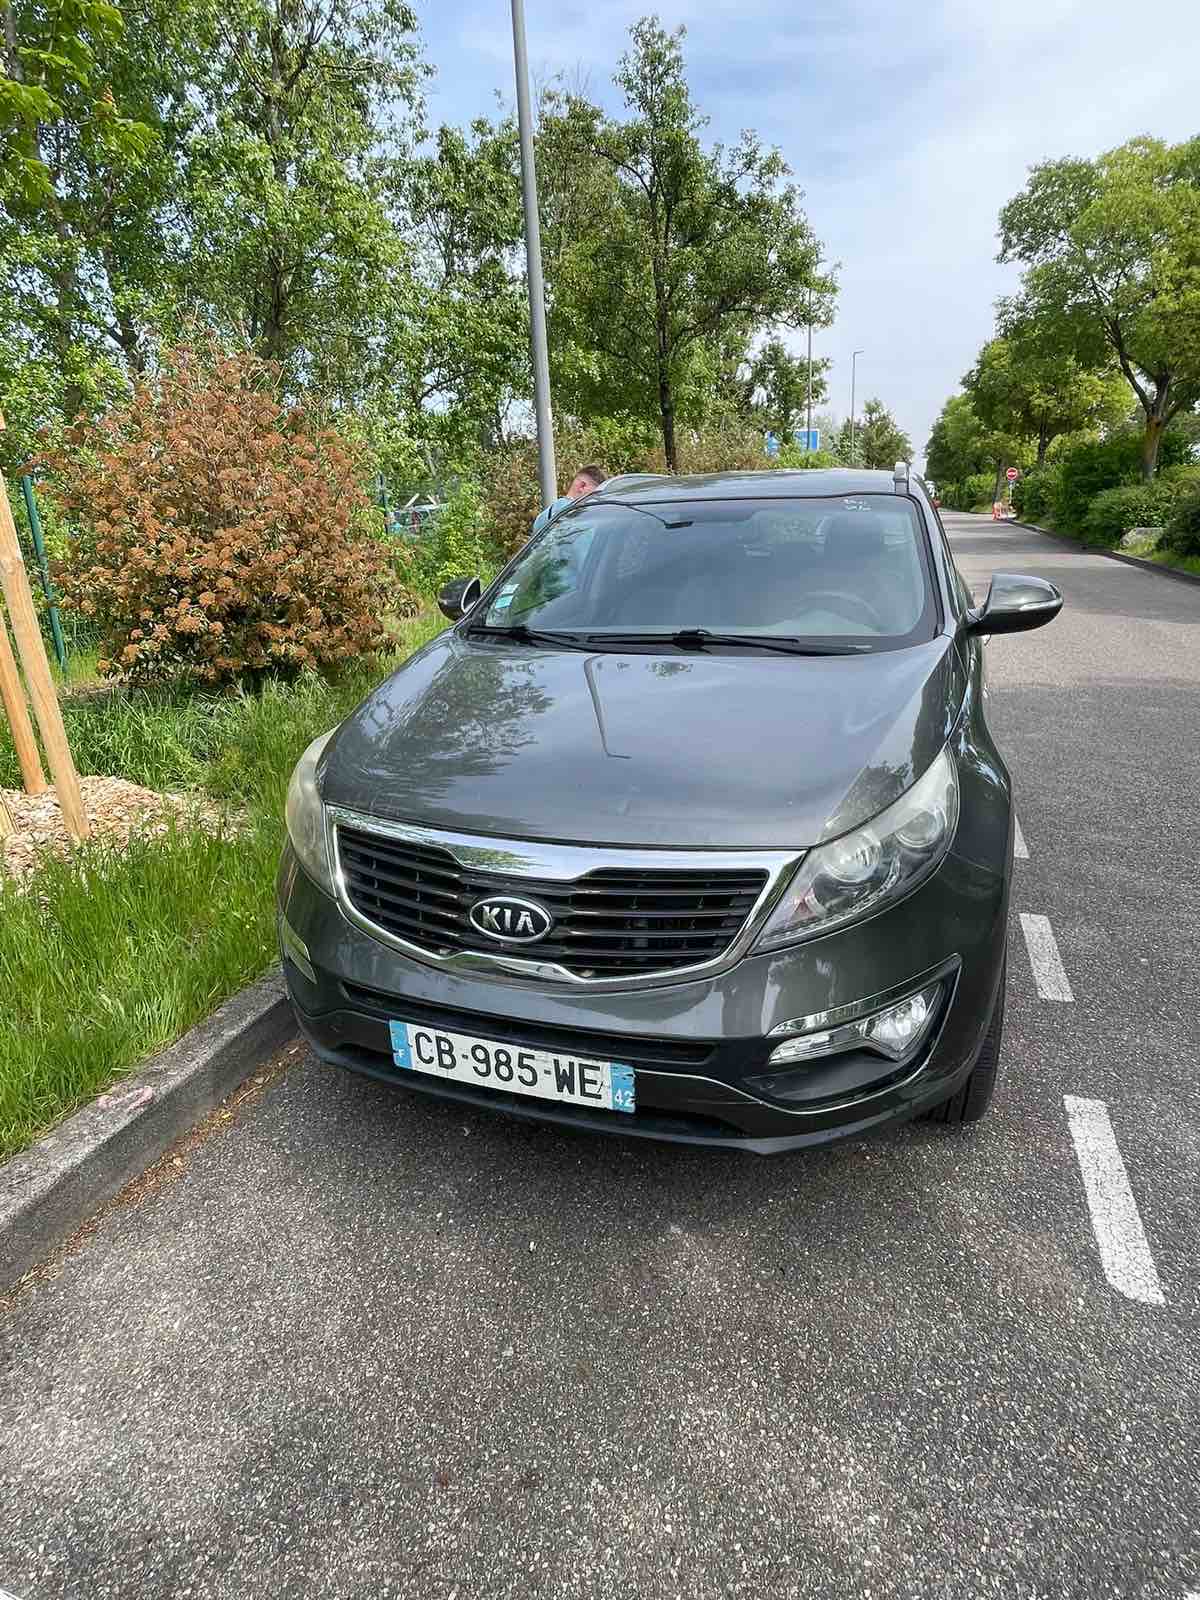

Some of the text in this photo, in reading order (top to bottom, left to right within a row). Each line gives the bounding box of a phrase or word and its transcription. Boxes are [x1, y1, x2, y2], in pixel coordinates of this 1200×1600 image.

[482, 905, 536, 934] KIA
[414, 1031, 603, 1100] CB-985-WE
[614, 1088, 636, 1107] 42
